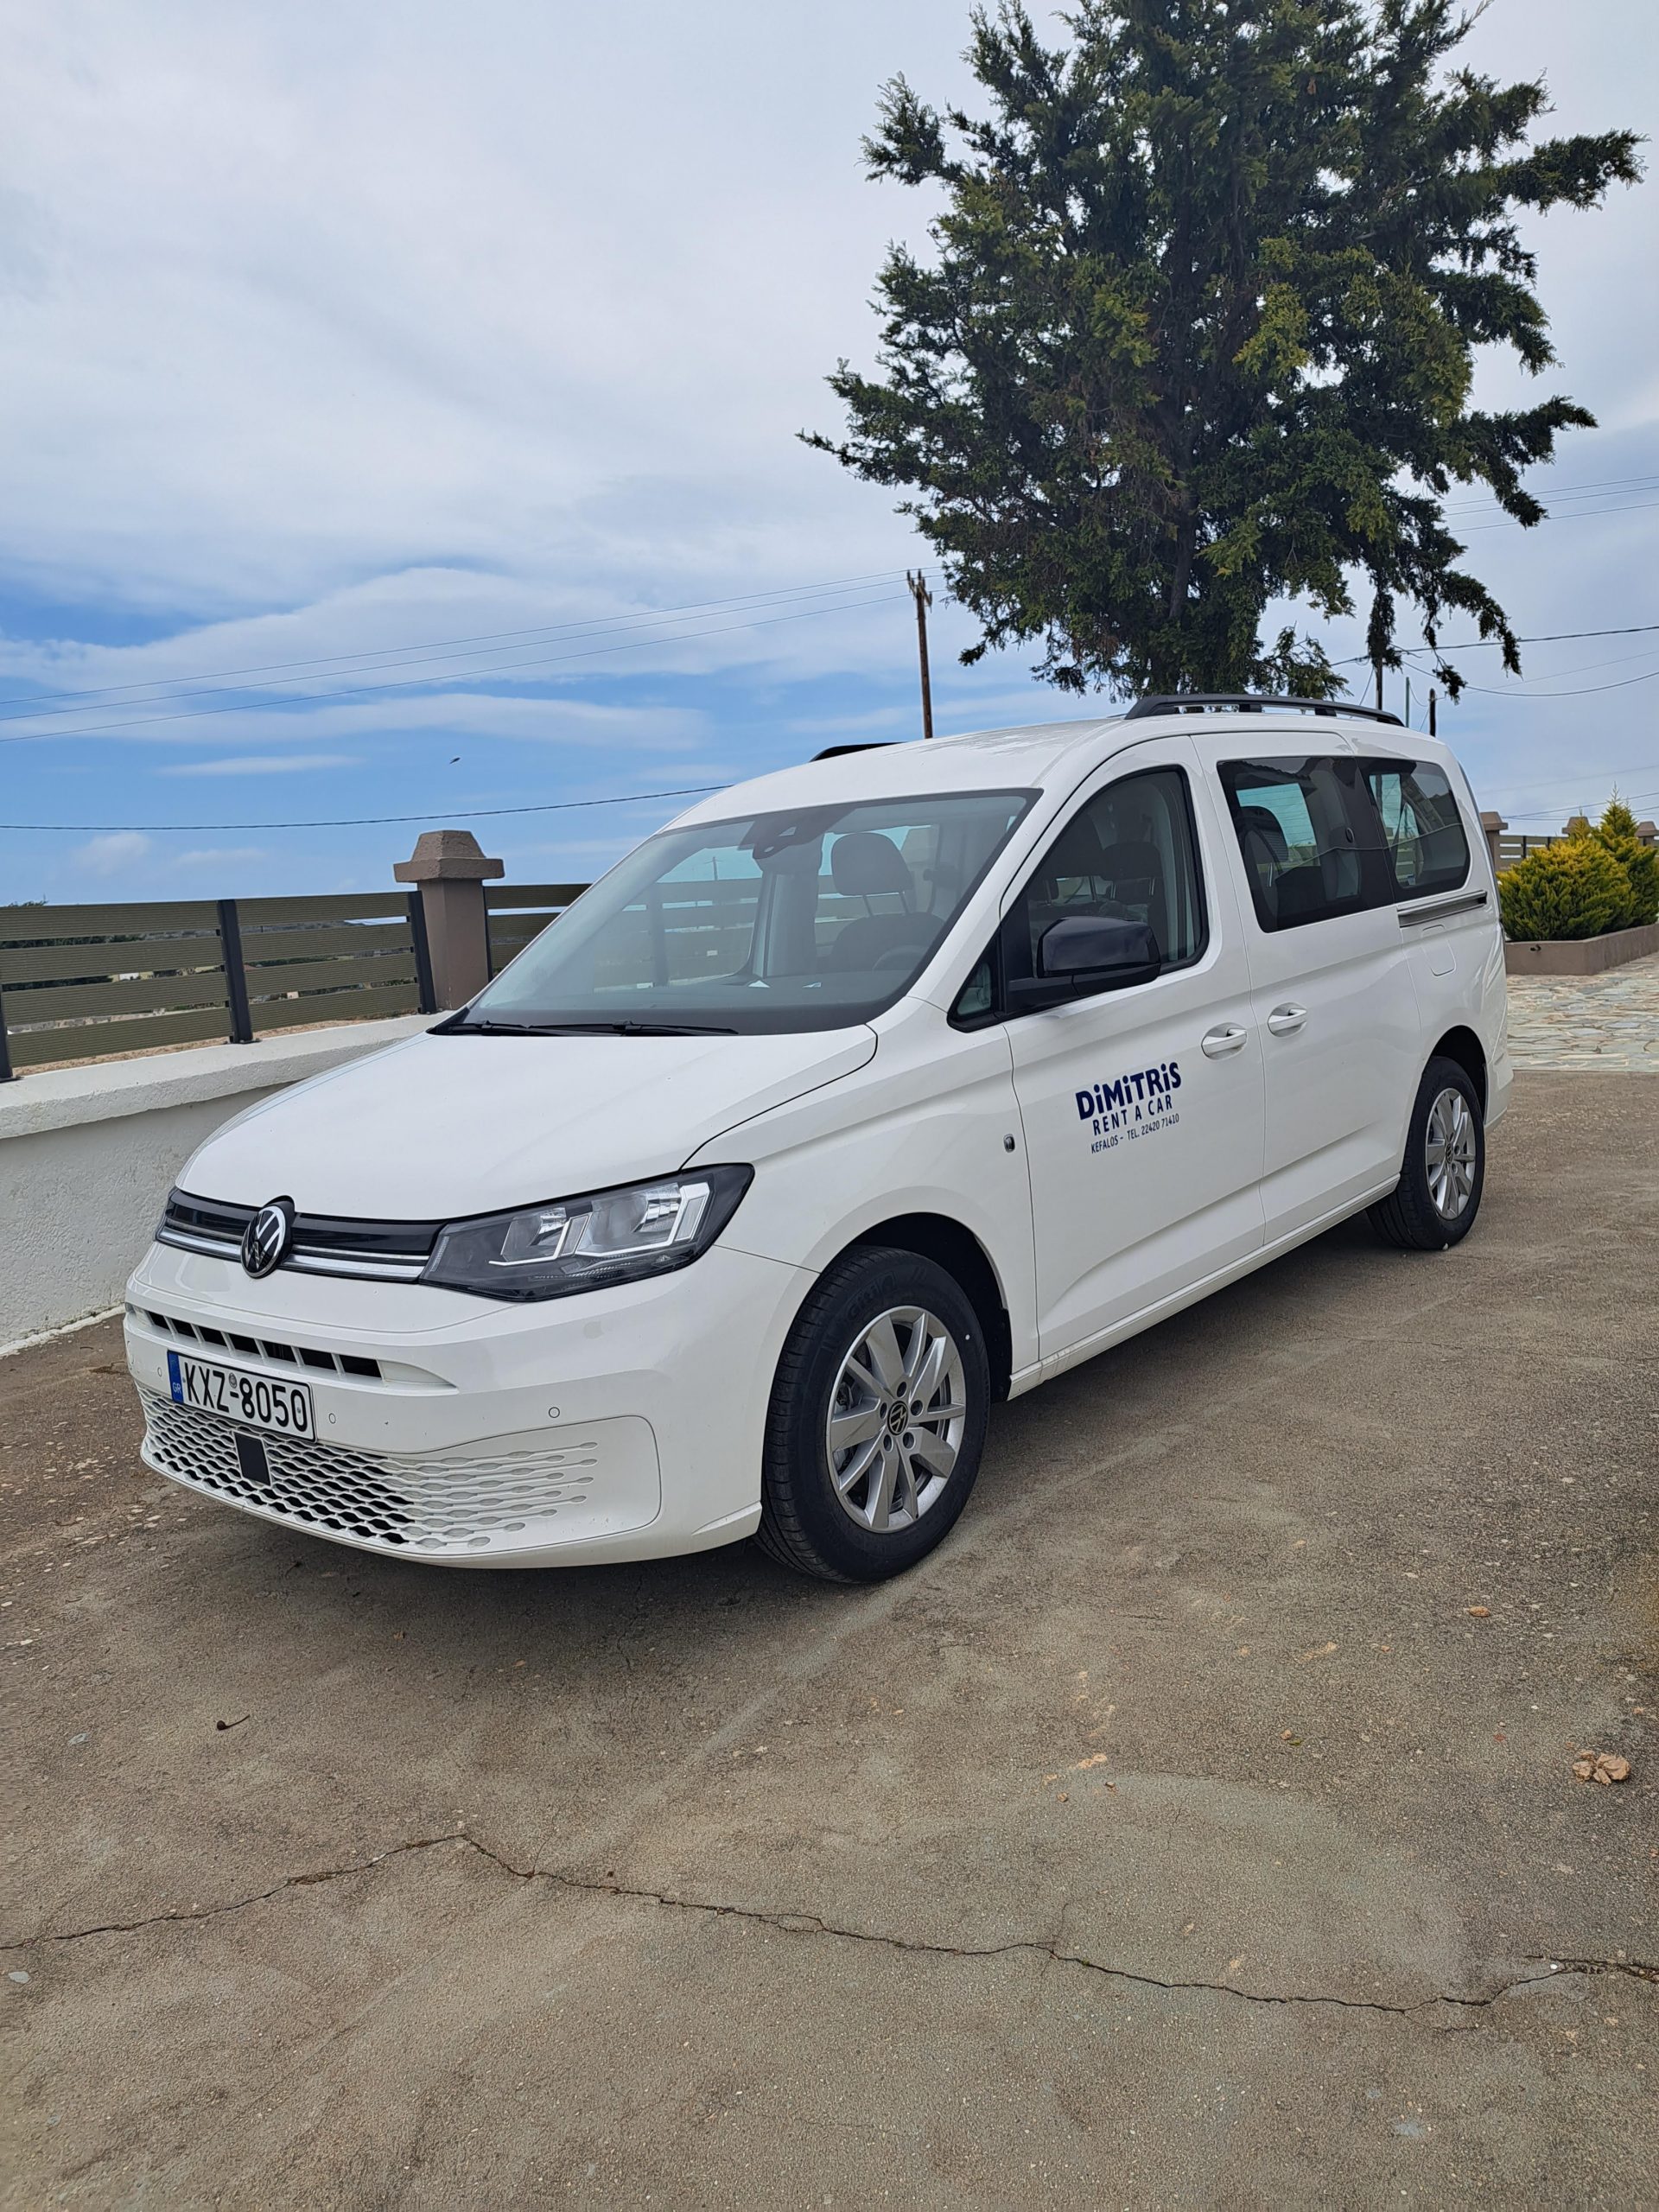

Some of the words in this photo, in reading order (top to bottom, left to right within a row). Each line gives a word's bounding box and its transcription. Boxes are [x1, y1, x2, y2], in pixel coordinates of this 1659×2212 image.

[1091, 1135, 1119, 1154] KEFALOS
[1127, 1128, 1140, 1141] TEL.
[1141, 1120, 1160, 1135] 22420
[1161, 1113, 1179, 1128] 71410
[1092, 1109, 1128, 1136] RENT
[1135, 1105, 1142, 1122] A
[1147, 1094, 1173, 1116] CAR
[173, 1382, 181, 1394] GR
[184, 1362, 308, 1432] KXZ-8050
